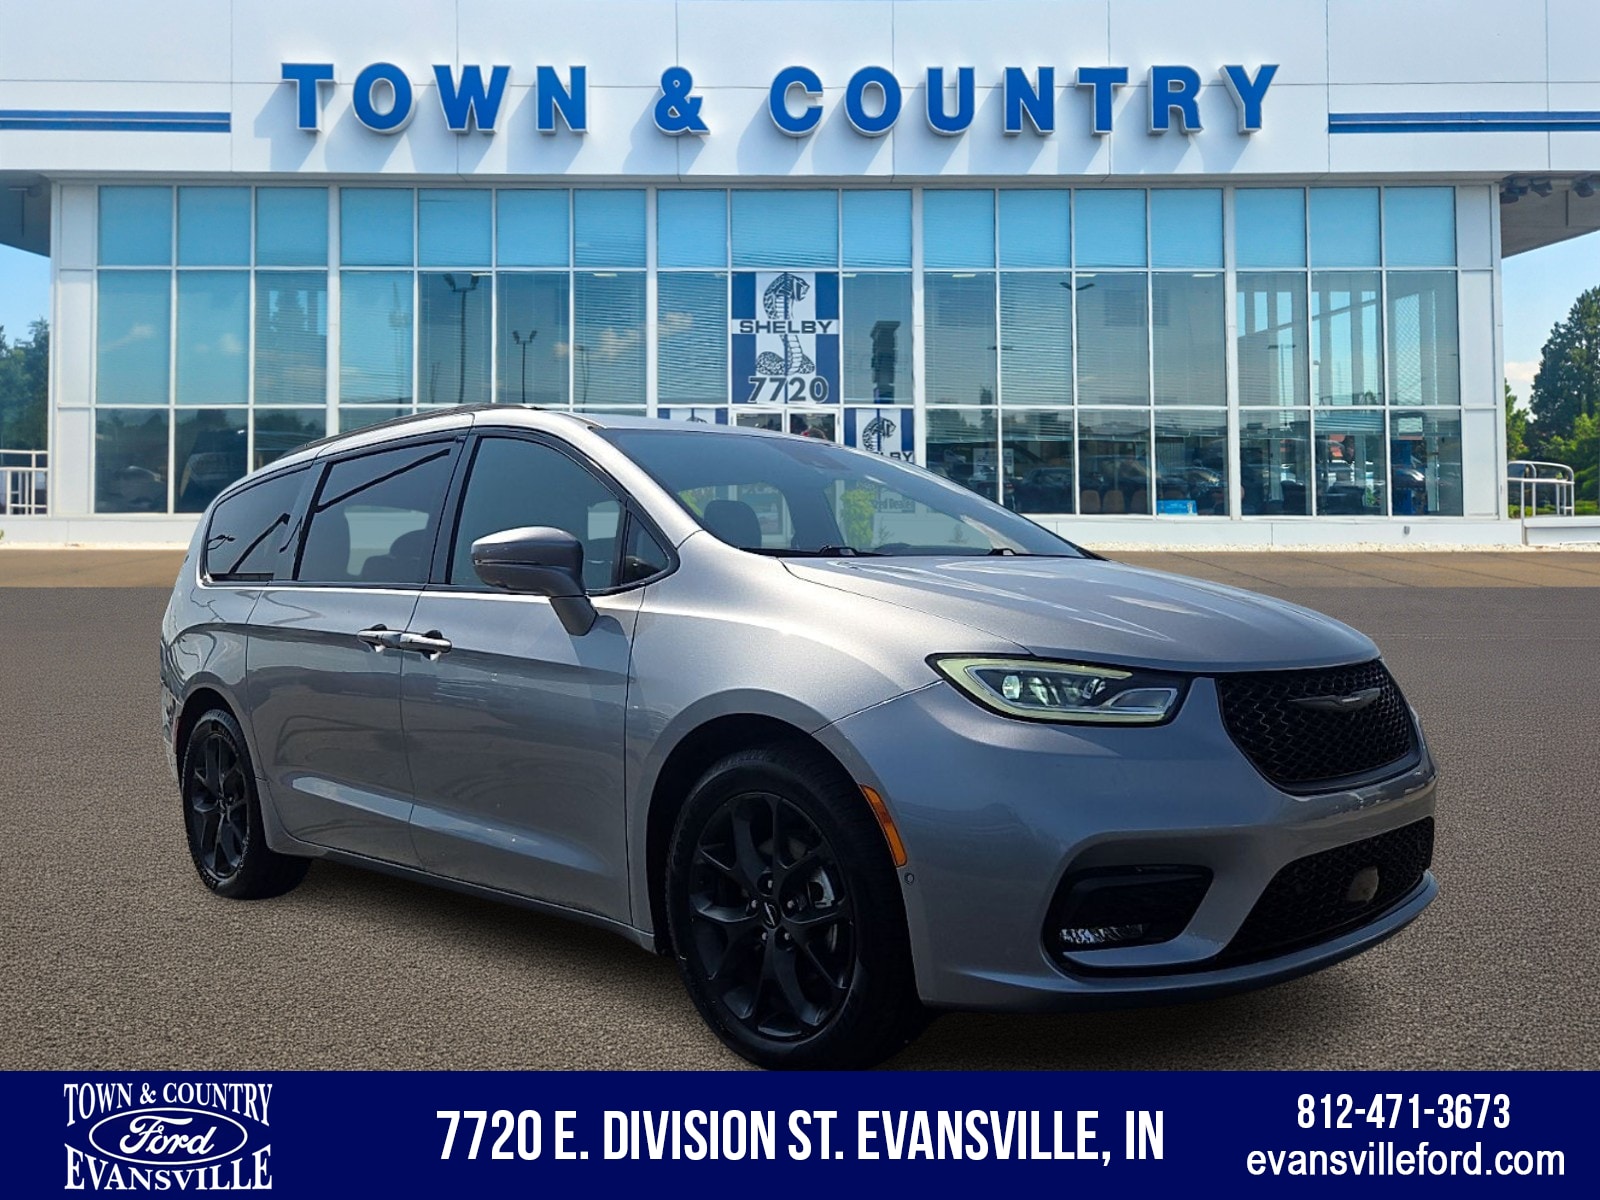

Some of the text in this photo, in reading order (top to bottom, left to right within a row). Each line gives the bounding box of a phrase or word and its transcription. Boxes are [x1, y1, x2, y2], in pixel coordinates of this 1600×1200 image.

[281, 62, 1279, 136] TOWN & COUNTRY
[740, 320, 832, 334] SHELBY
[748, 375, 829, 403] 7720
